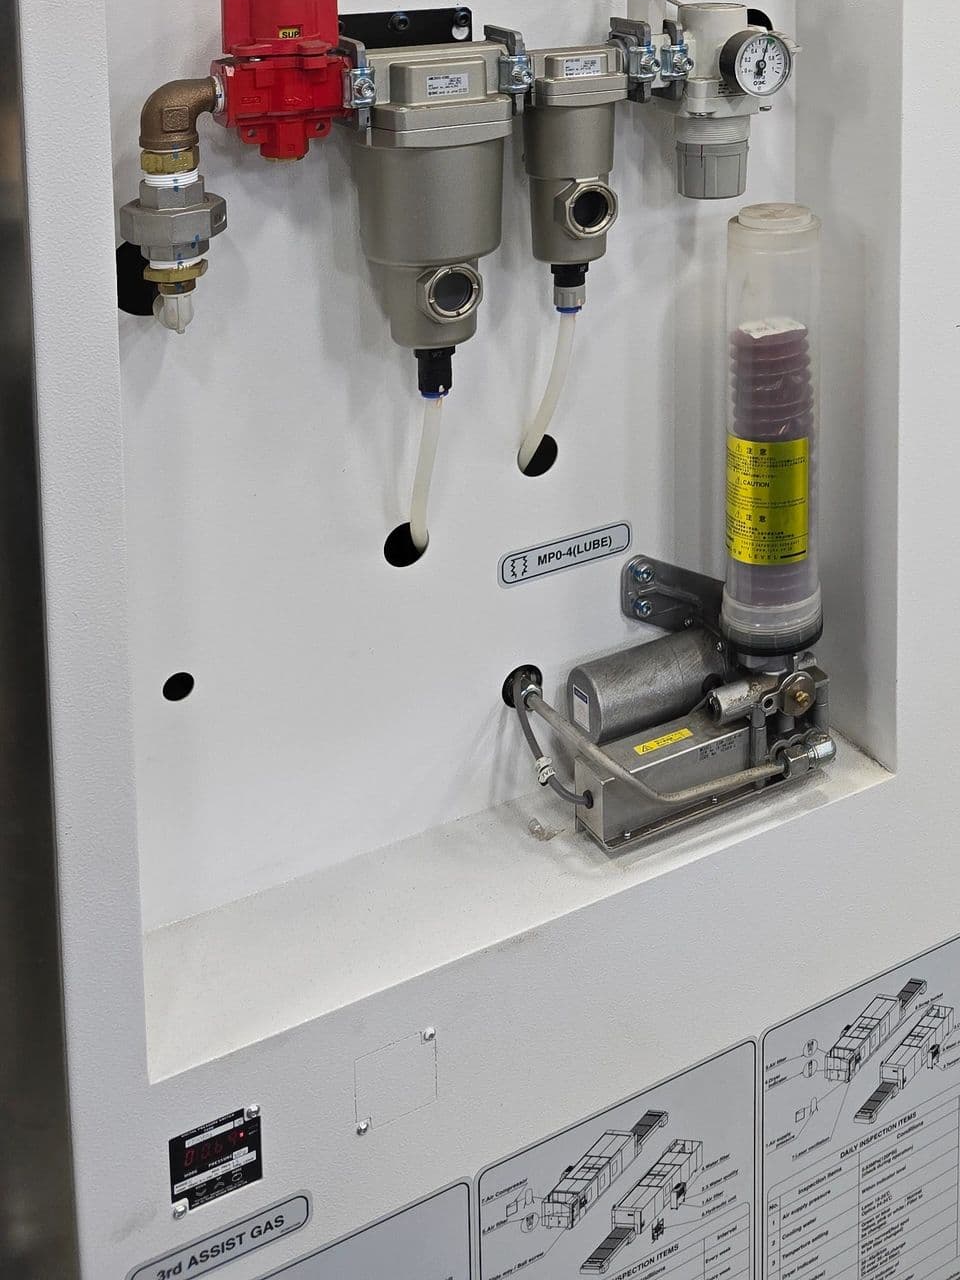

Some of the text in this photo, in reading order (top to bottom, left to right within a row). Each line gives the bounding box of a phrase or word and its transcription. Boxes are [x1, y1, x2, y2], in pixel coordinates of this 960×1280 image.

[282, 31, 300, 39] SUP
[742, 479, 770, 489] CAUTION
[748, 550, 778, 560] LEVEL
[840, 1111, 916, 1158] DAILY INSPECTION ITEMS
[896, 1121, 923, 1138] Conditions
[791, 1202, 807, 1215] supply
[809, 1189, 830, 1205] pressure
[782, 1217, 816, 1239] Cooling water
[156, 1214, 285, 1280] 3rd ASSIST GAS
